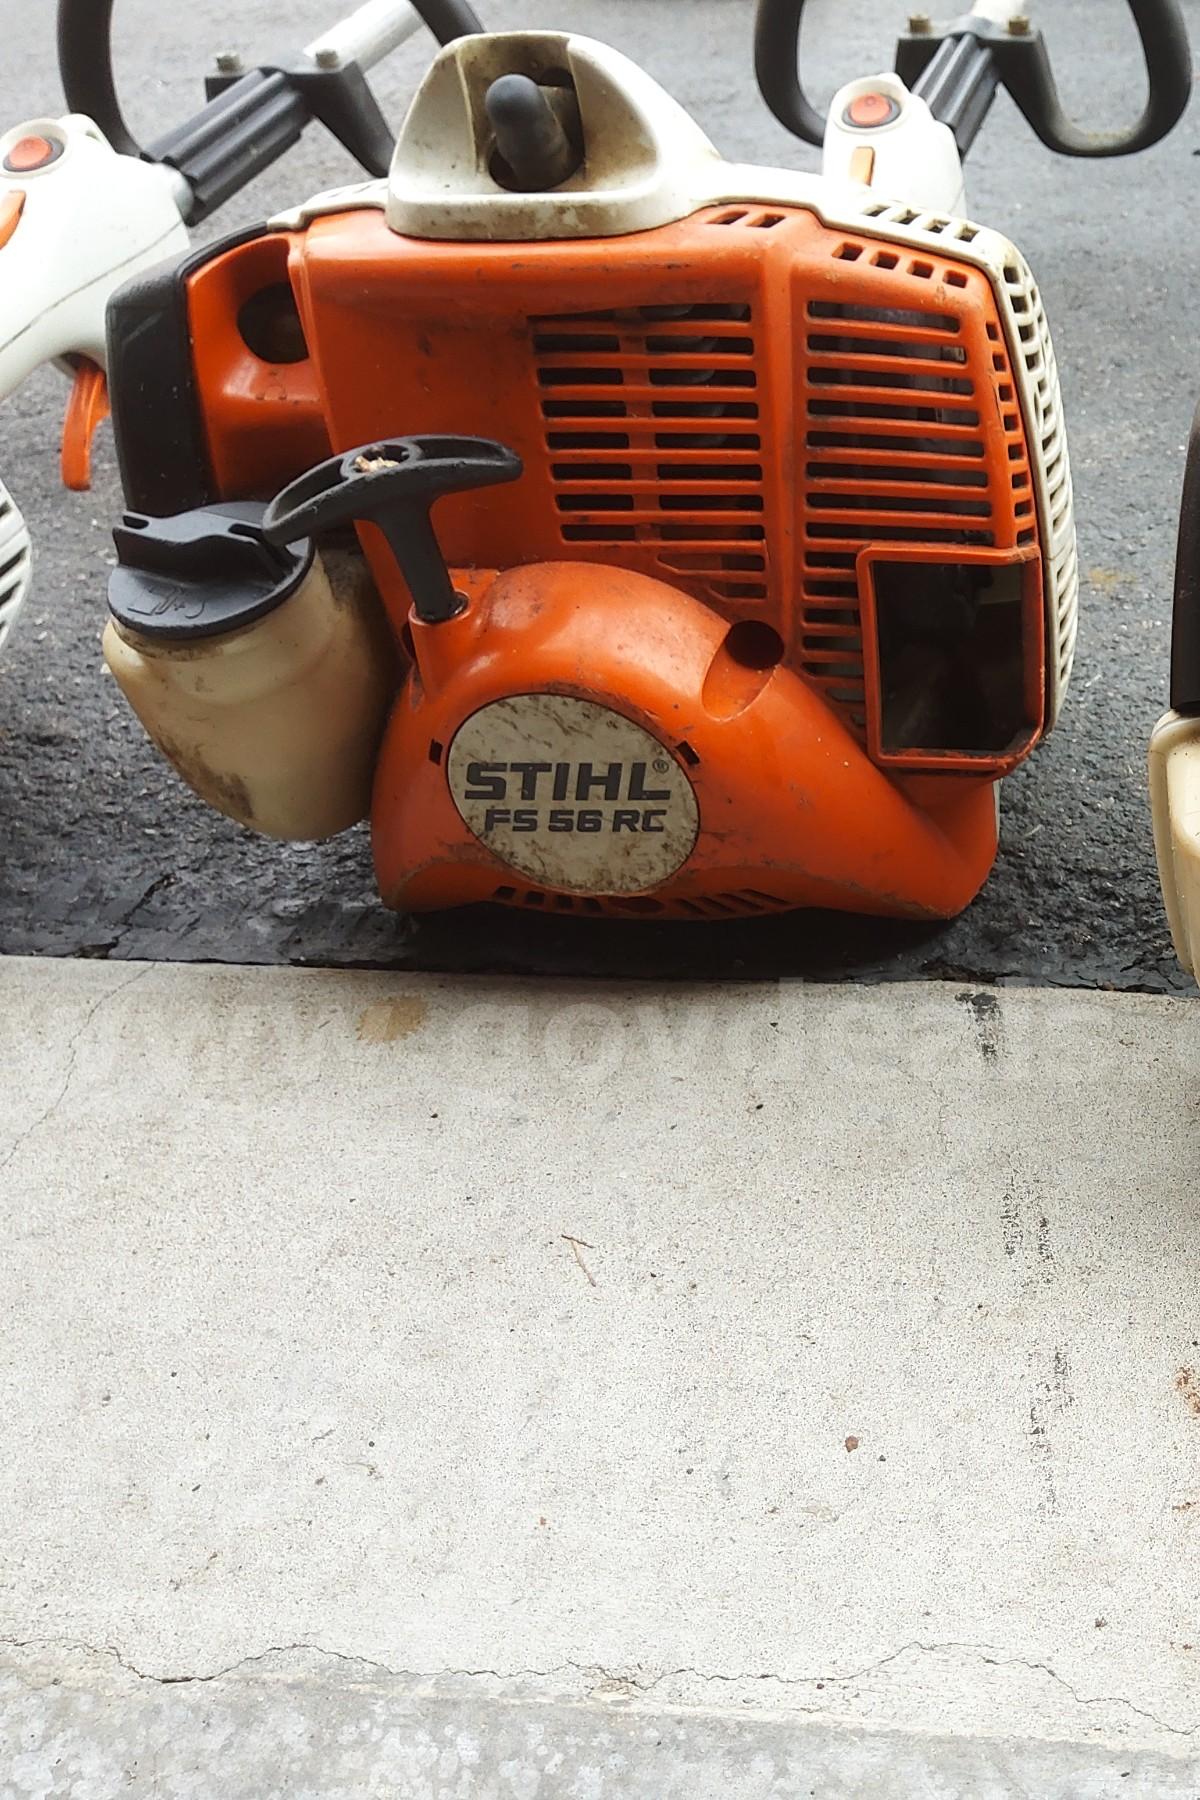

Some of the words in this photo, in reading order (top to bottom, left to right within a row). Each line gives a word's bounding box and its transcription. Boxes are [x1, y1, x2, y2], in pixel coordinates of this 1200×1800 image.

[464, 762, 671, 801] STIHL
[484, 808, 538, 832] FS
[548, 809, 603, 832] 56
[612, 809, 667, 832] RC
